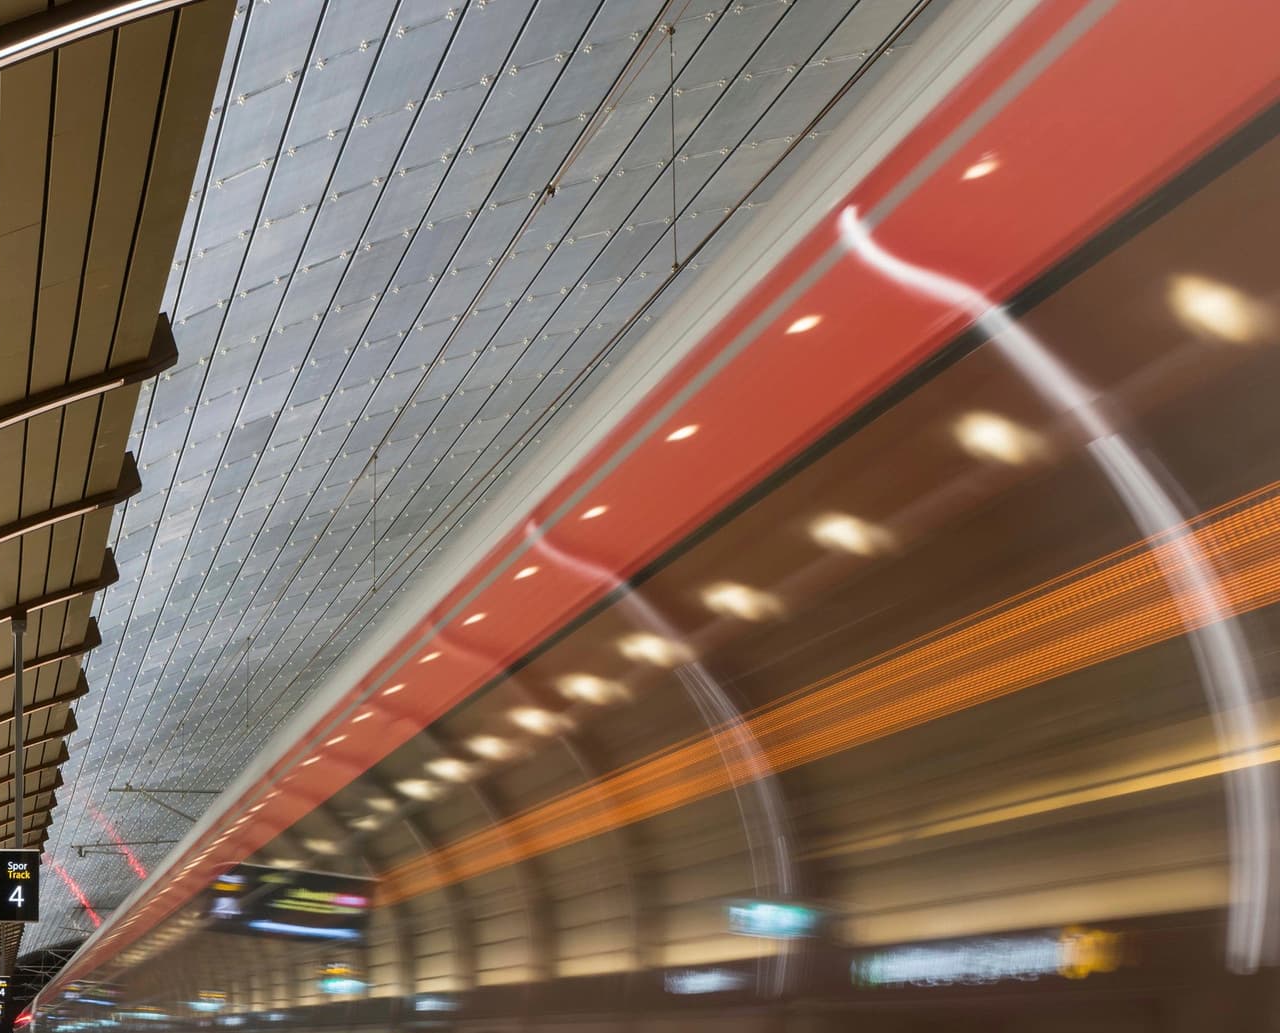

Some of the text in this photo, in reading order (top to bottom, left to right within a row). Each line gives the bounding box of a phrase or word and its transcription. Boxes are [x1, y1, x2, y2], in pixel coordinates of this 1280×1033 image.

[7, 861, 28, 871] Spor
[7, 870, 31, 879] Track
[8, 885, 25, 908] 4
